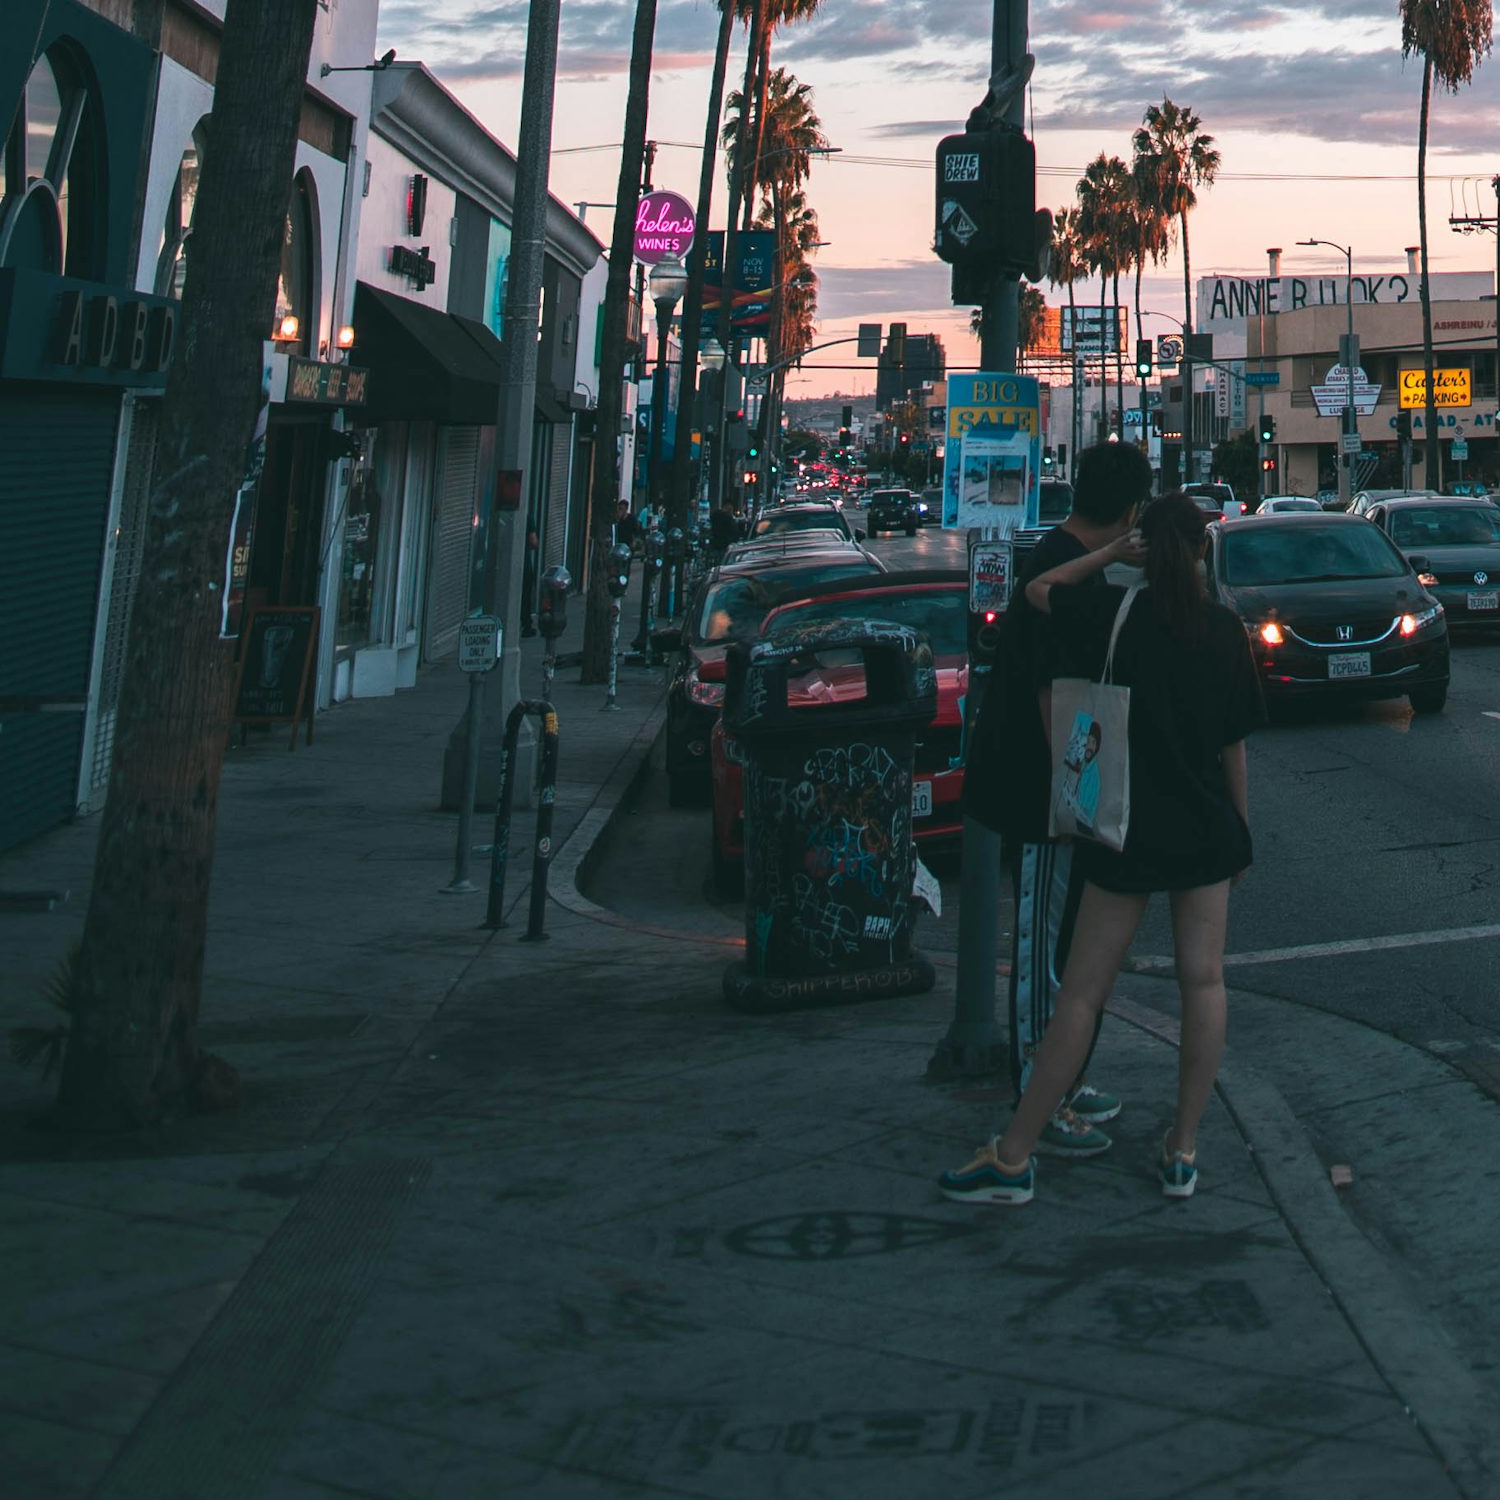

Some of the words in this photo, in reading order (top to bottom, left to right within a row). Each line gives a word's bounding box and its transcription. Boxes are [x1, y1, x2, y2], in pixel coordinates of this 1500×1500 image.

[945, 167, 978, 181] DREW
[634, 199, 695, 233] helen's
[638, 238, 681, 251] WINES
[743, 258, 764, 266] NOV
[1434, 320, 1484, 330] ASHREINU
[971, 380, 1020, 403] BIG
[1412, 392, 1459, 405] PAKING
[462, 623, 496, 633] PASSENGER
[465, 635, 490, 645] LOADING
[469, 647, 485, 657] ONLY
